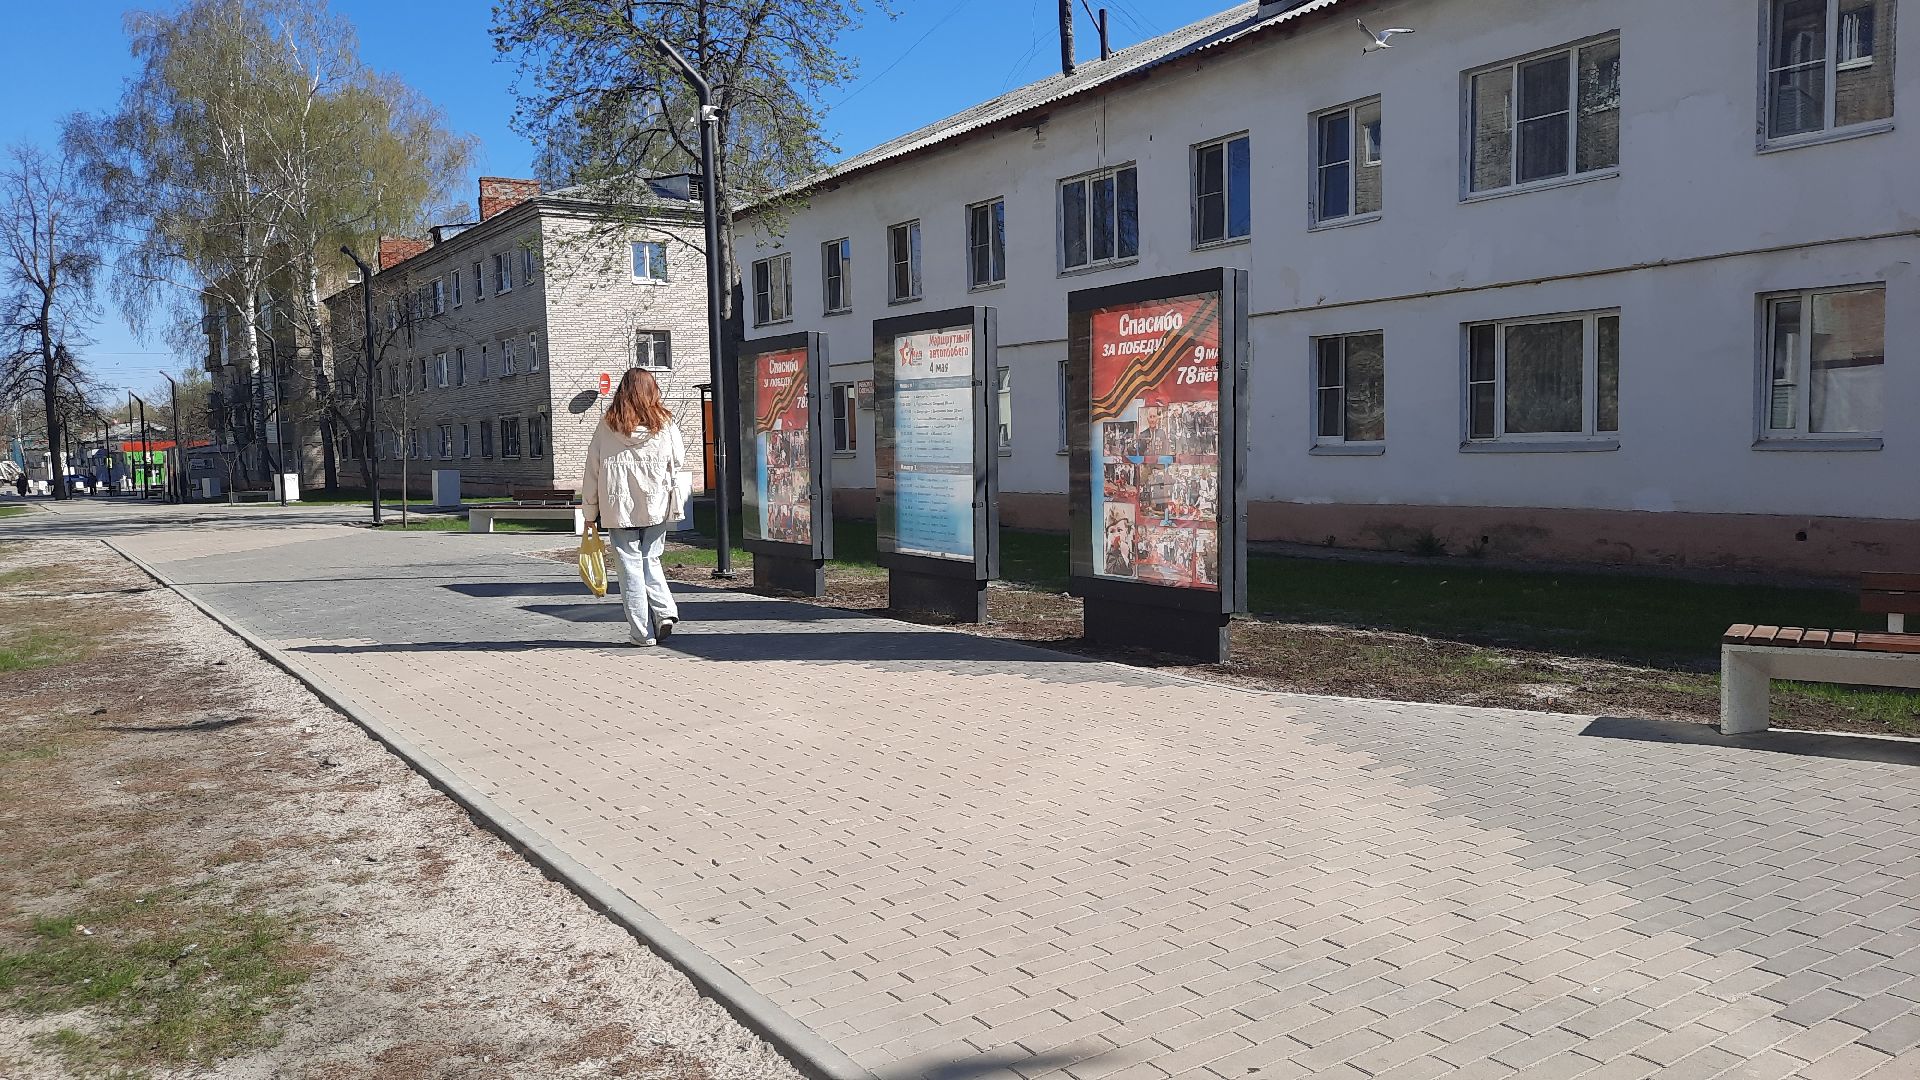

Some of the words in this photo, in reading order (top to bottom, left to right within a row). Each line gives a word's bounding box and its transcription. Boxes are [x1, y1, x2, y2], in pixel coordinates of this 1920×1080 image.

[1120, 309, 1183, 336] Спасибо
[1102, 344, 1116, 357] ЗА
[1118, 338, 1167, 355] ПОБЕДУ!
[1194, 345, 1205, 364] 9
[769, 357, 798, 374] Спасибо
[929, 362, 934, 373] 4
[1177, 365, 1197, 384] 78
[1196, 371, 1218, 383] лет
